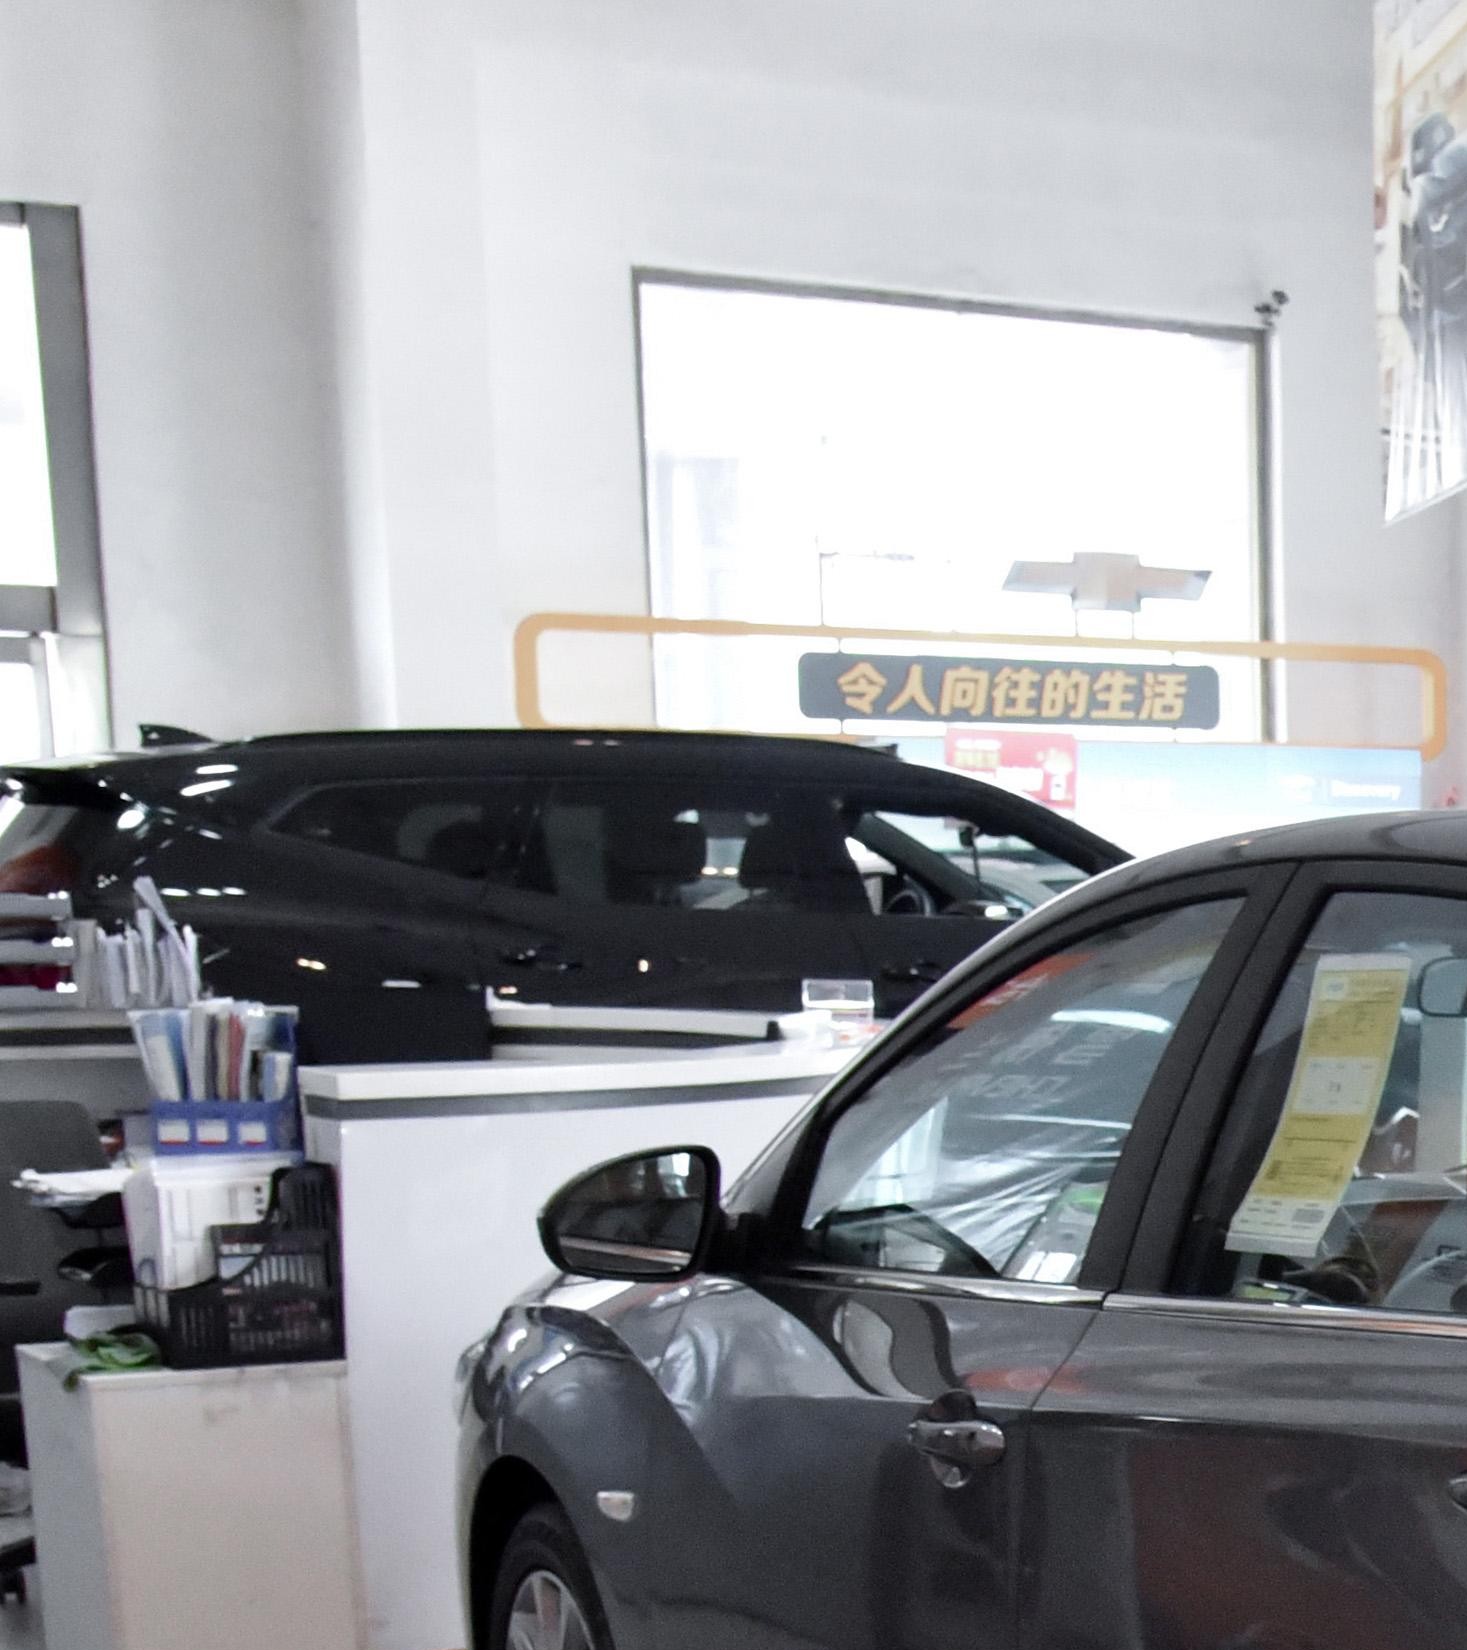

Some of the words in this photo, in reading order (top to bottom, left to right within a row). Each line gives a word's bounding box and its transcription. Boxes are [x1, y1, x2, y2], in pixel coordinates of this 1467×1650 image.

[836, 660, 1188, 721] 令人向往的生活
